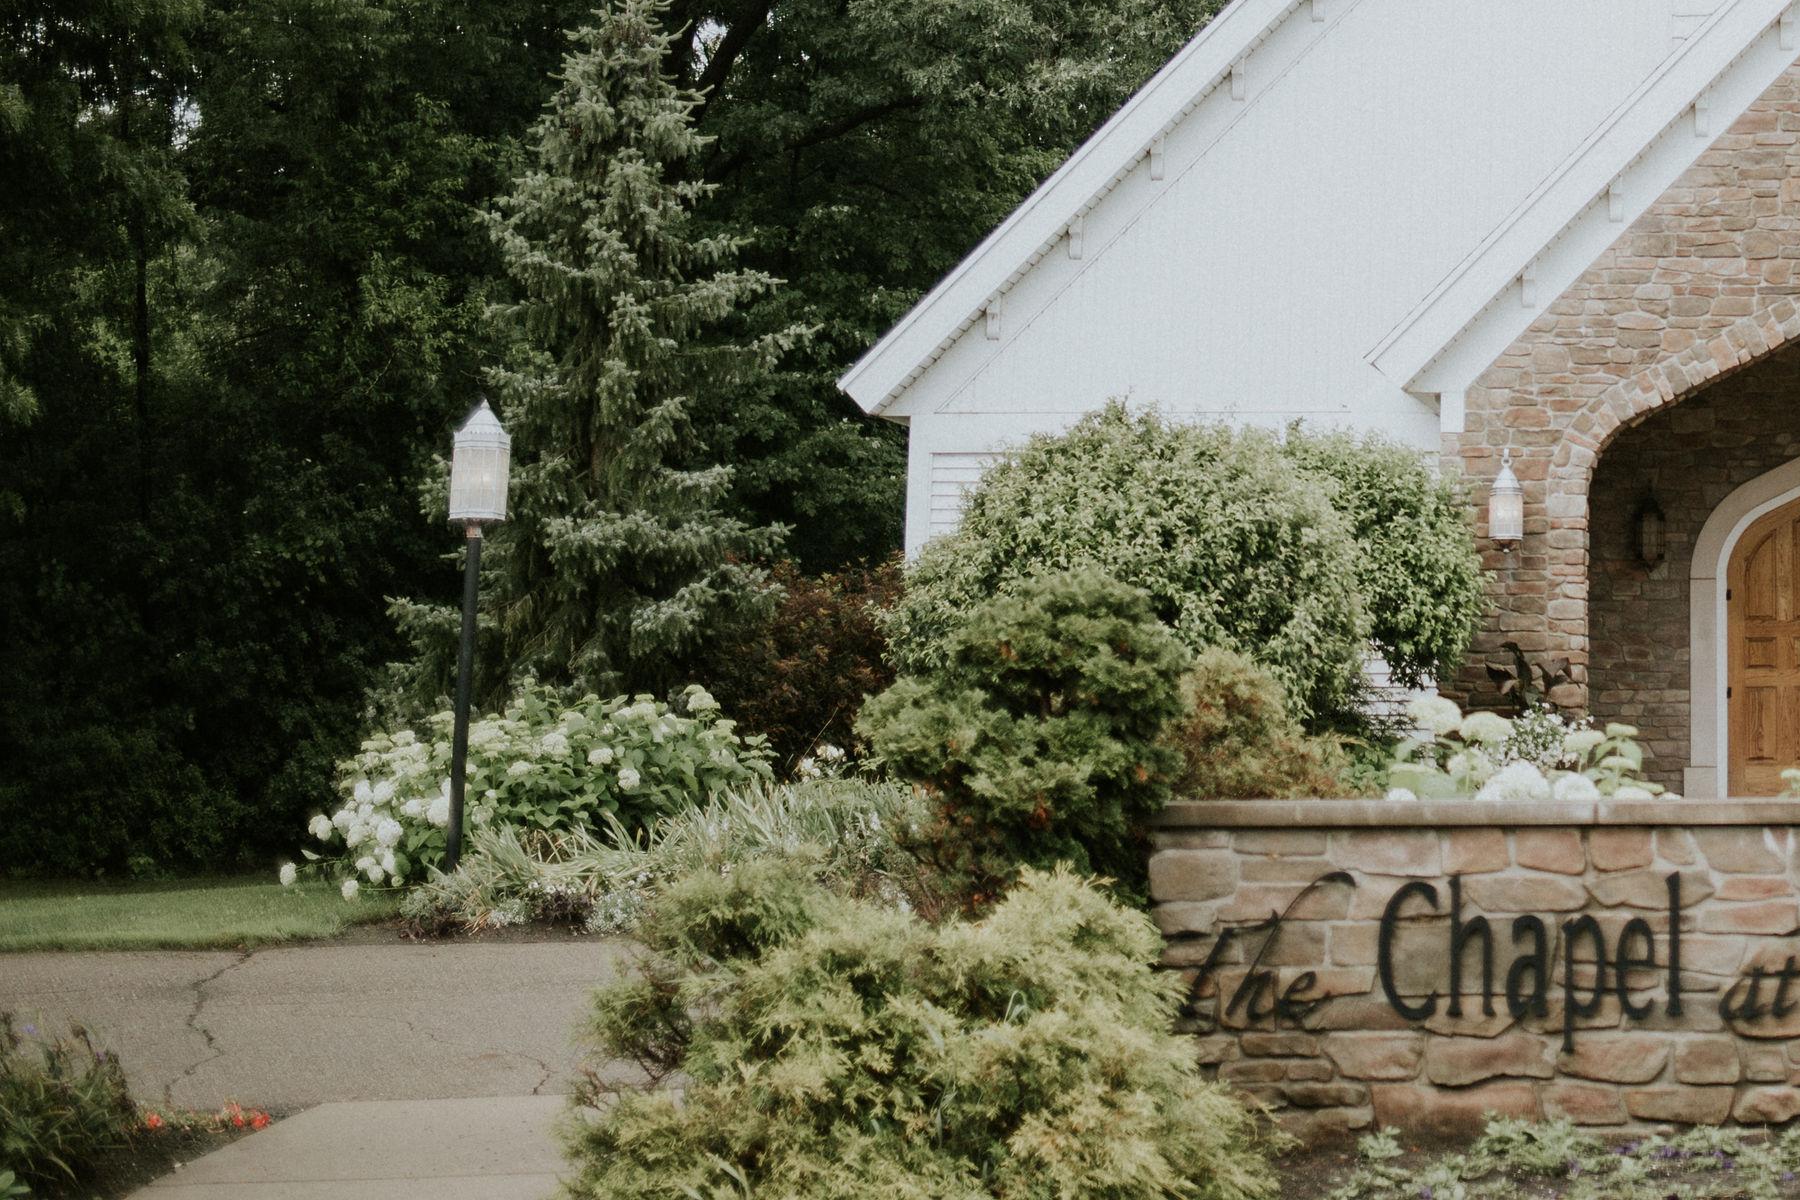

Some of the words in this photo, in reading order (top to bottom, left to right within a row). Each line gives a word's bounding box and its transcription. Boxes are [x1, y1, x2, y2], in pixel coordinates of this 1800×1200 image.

[1167, 871, 1357, 1024] The
[1376, 871, 1682, 1054] Chapel
[1718, 953, 1800, 1022] at
